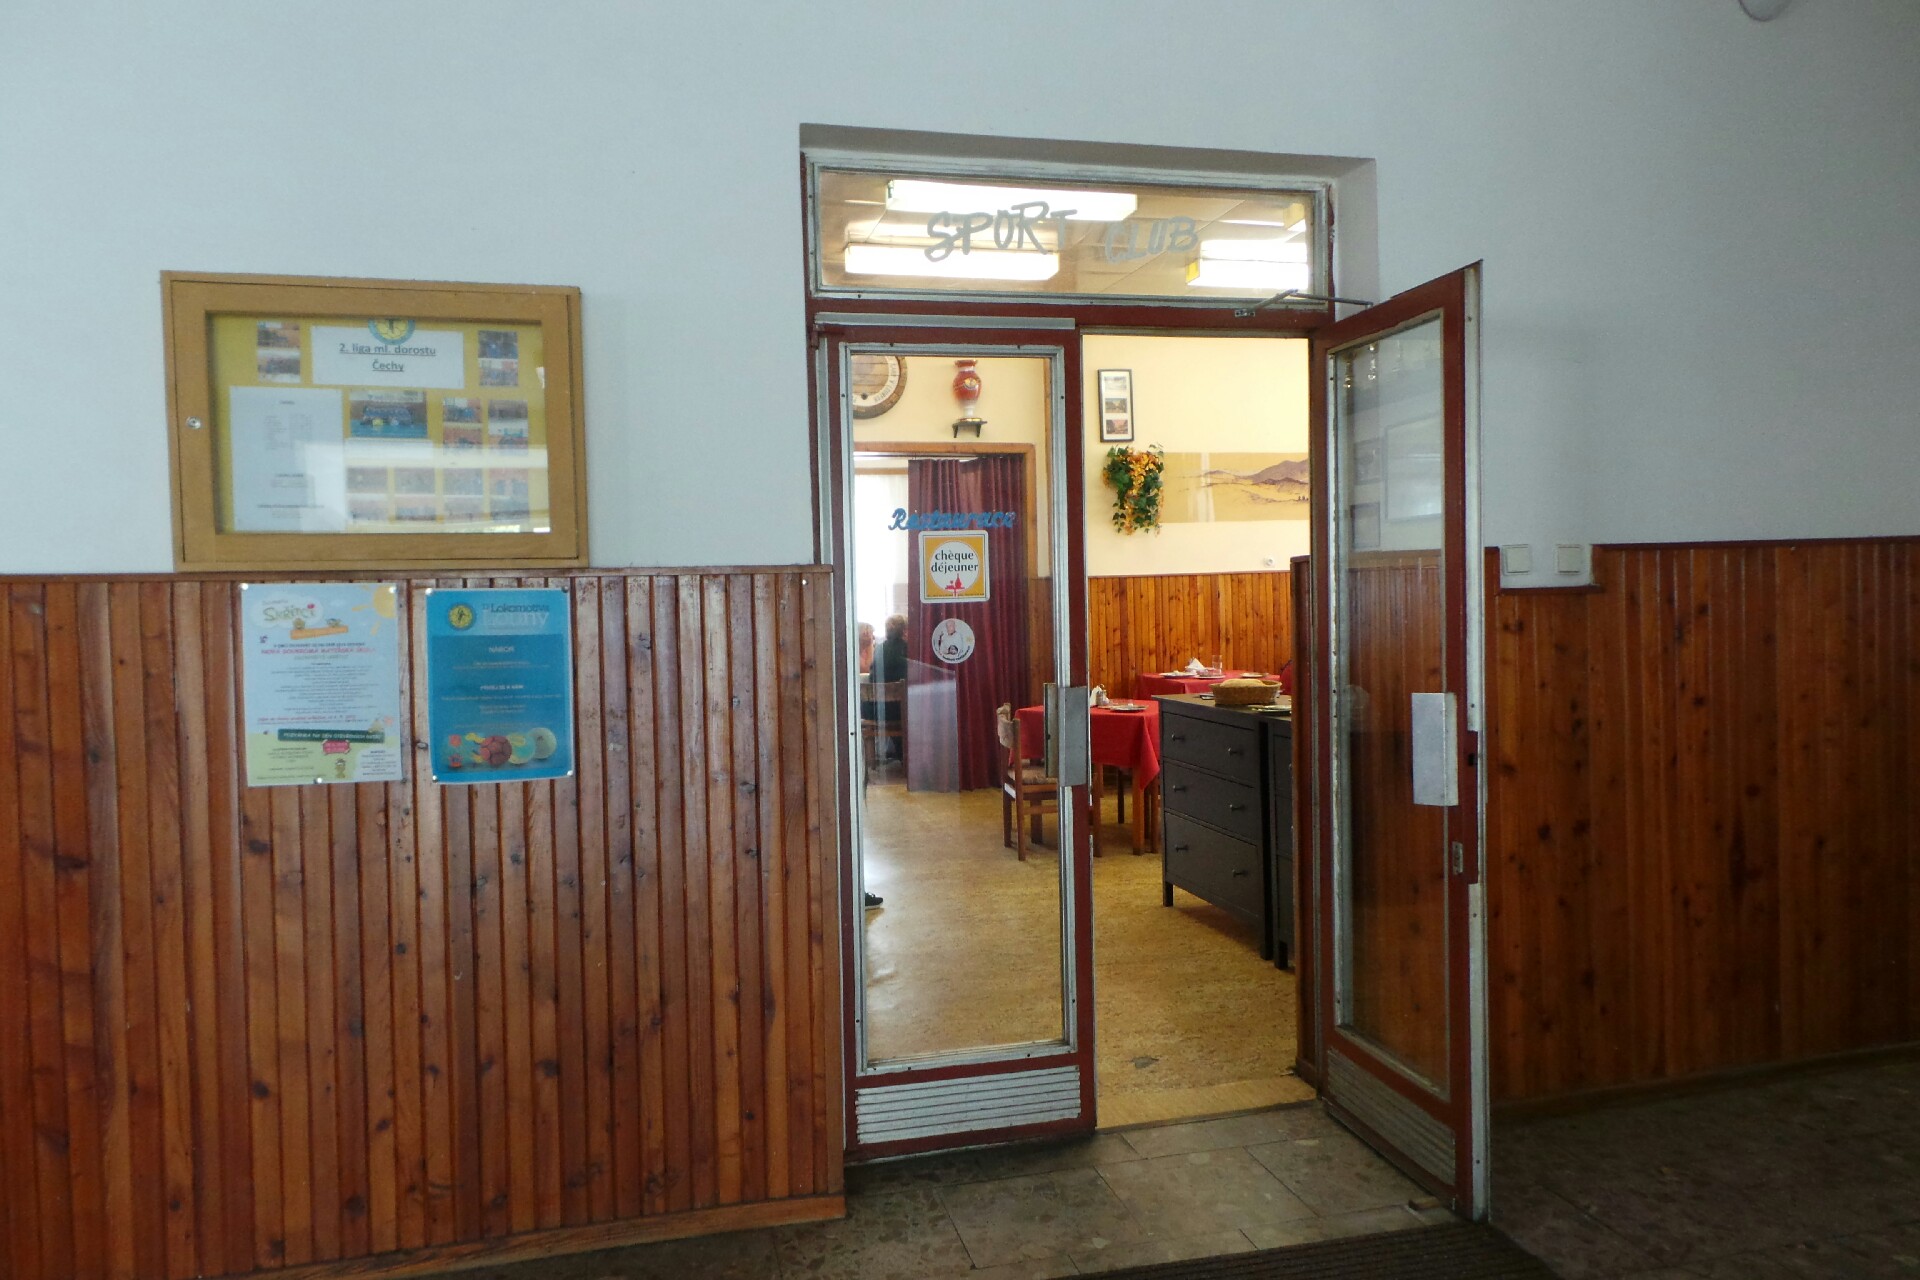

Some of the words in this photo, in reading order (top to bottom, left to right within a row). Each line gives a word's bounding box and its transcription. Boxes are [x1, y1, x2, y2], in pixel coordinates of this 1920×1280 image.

[924, 201, 1077, 262] SPORT
[1105, 216, 1198, 264] CLUB
[339, 343, 350, 353] 2.
[352, 344, 371, 354] liga
[374, 345, 392, 353] ml.
[394, 345, 436, 355] dorostu
[372, 359, 404, 372] Čechy
[935, 550, 974, 563] chèque
[931, 562, 978, 576] déjeuner
